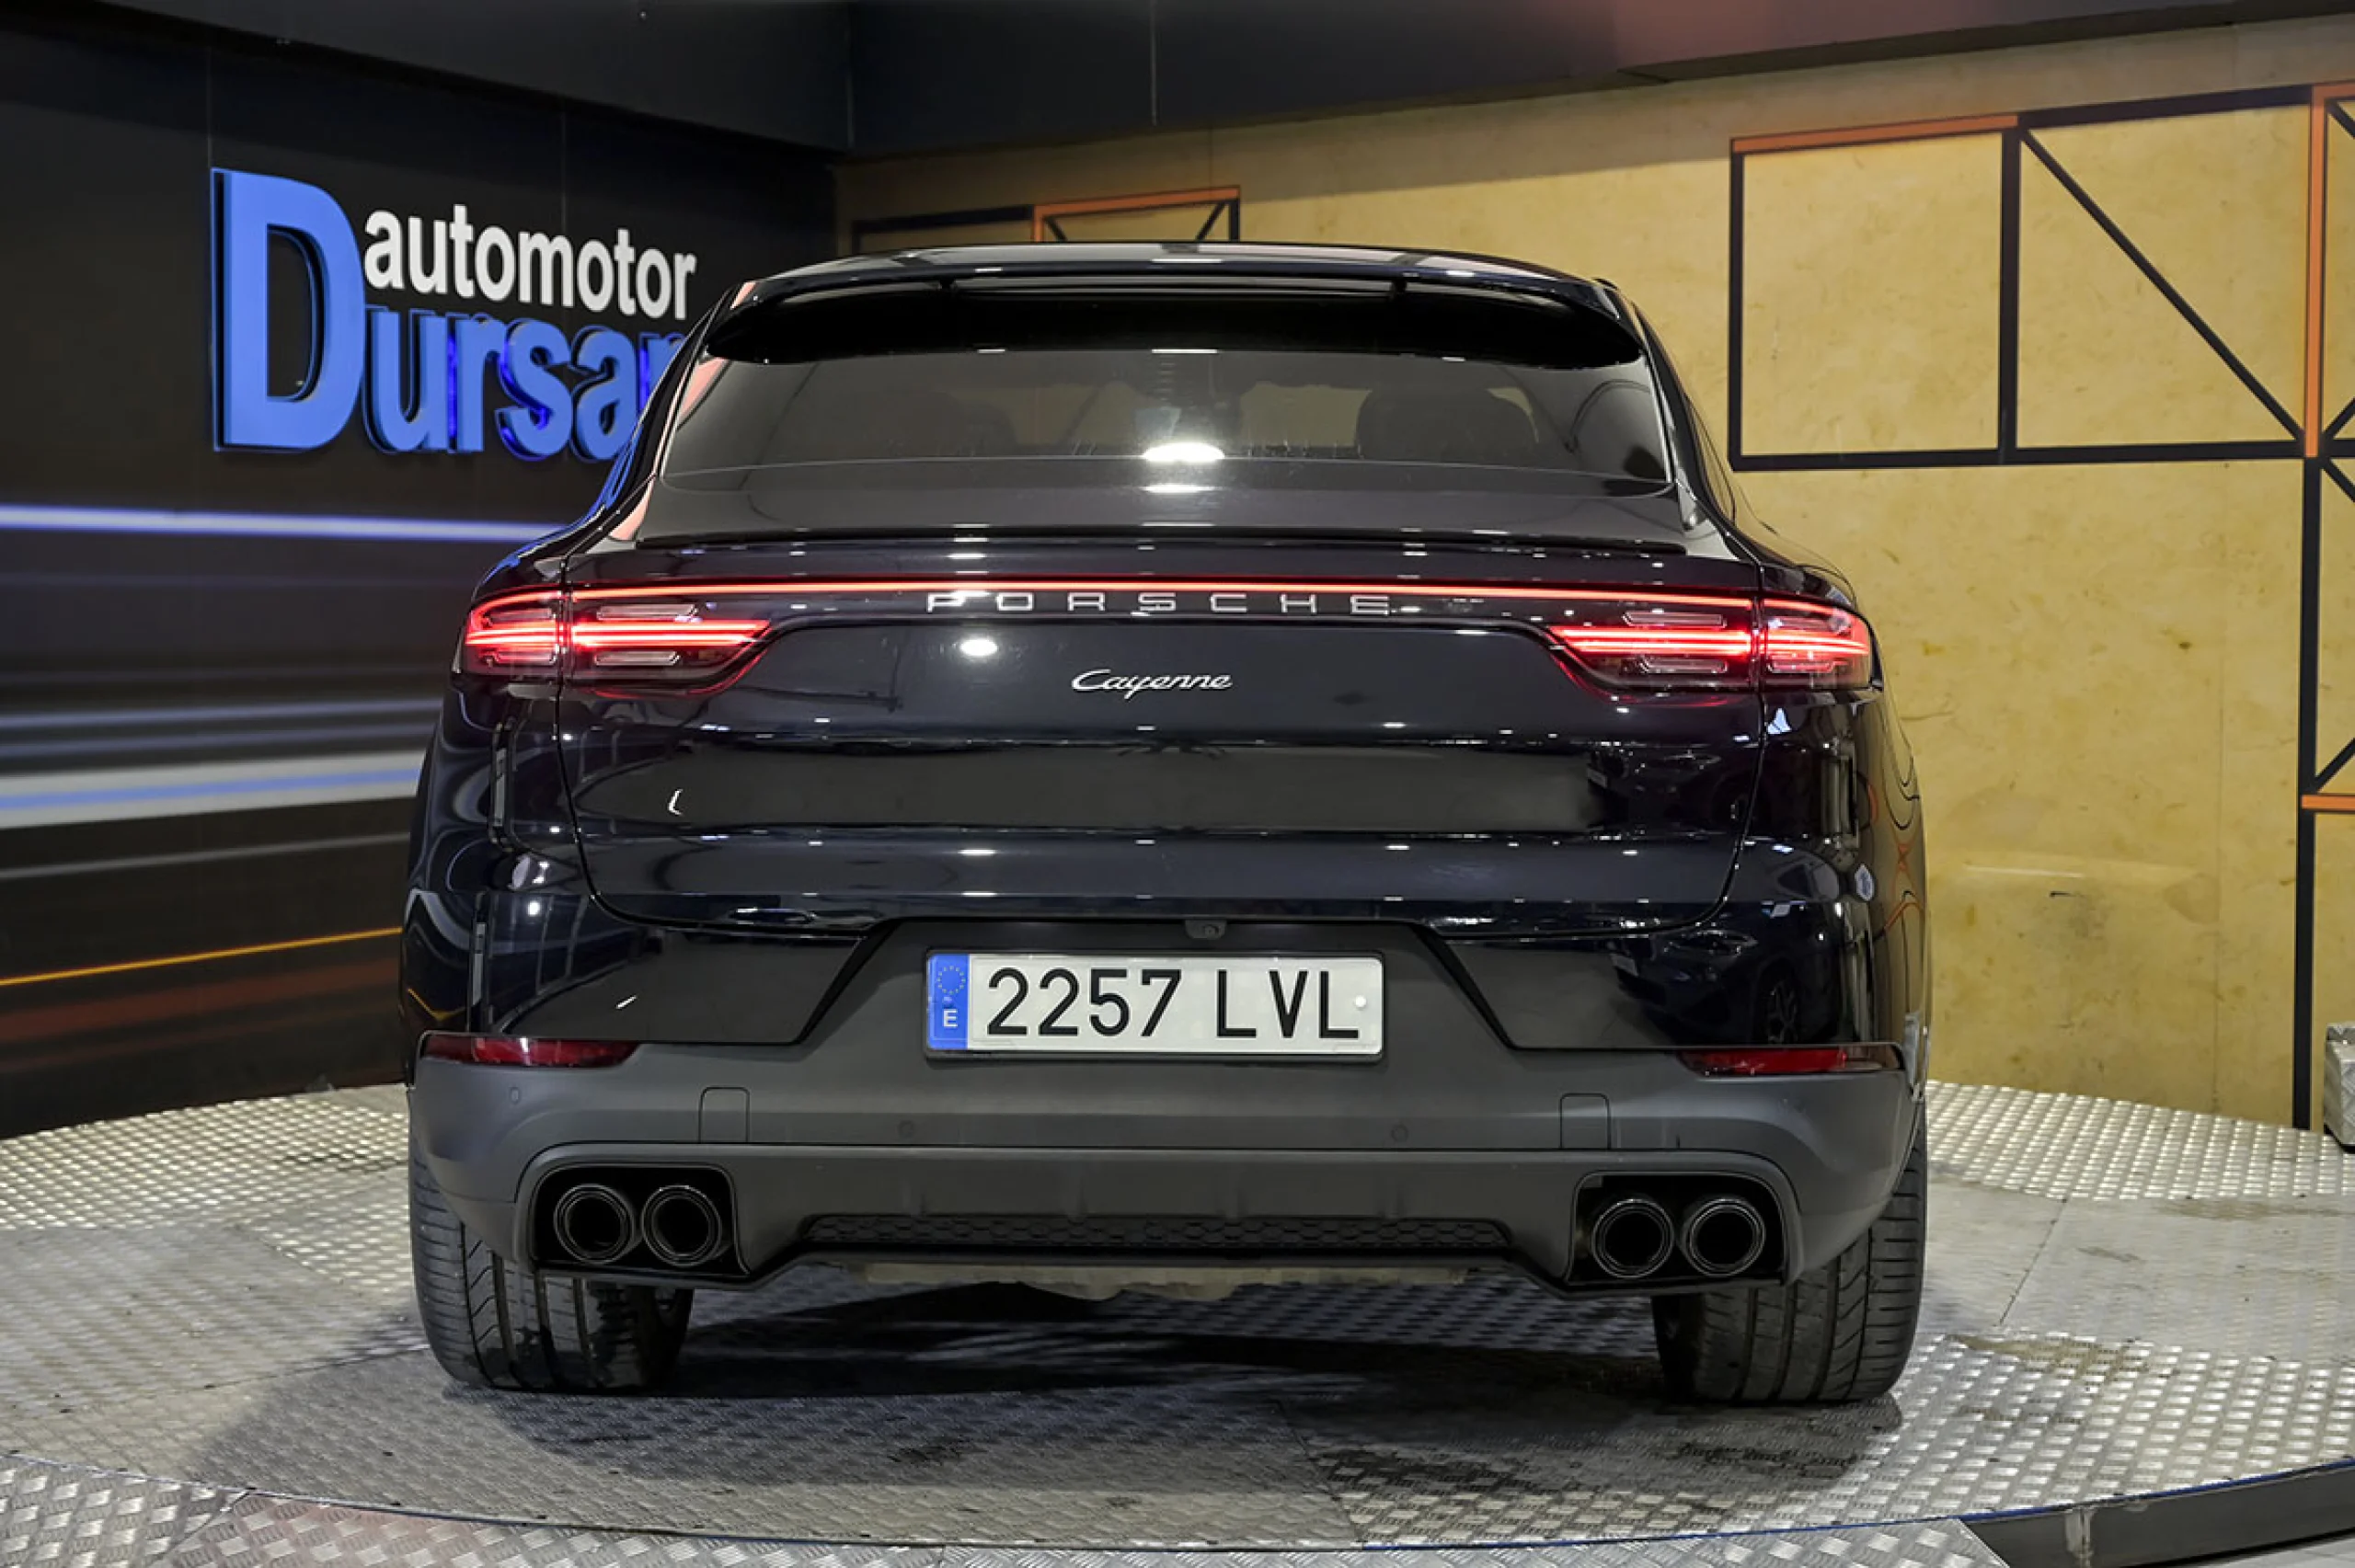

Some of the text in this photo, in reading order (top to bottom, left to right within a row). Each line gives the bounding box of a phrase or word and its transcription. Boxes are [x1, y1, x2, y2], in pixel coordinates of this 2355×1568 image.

[364, 204, 696, 320] automotor
[926, 591, 1390, 615] PORSCHE
[1072, 669, 1233, 699] Cayenne
[942, 1008, 959, 1028] E
[986, 967, 1360, 1039] 2257 LVL
